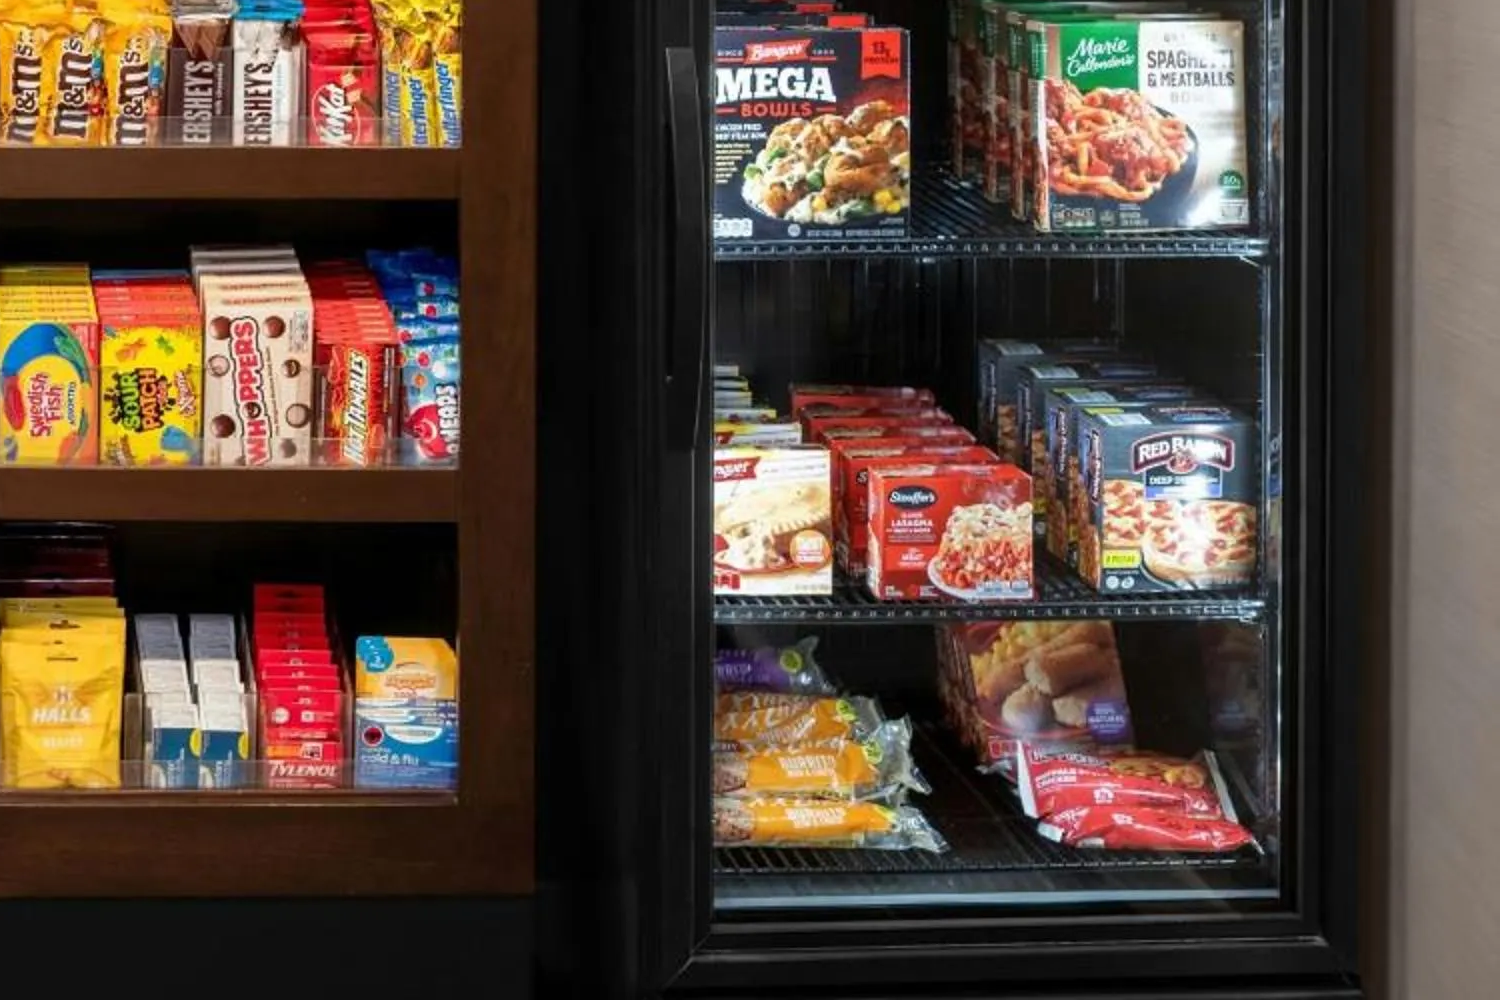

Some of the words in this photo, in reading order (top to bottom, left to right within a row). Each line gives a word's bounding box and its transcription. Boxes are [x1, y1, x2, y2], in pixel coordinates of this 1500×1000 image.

[1069, 37, 1130, 59] Marie
[716, 67, 837, 104] MEGA
[1160, 71, 1235, 87] MEATBALLS
[183, 60, 213, 144] ERSHEY'S
[244, 62, 273, 145] ERSHEY'S
[741, 102, 813, 118] BOWLS
[28, 372, 51, 438] Swedish
[120, 374, 141, 429] SOUR
[139, 368, 161, 430] PATCH
[1138, 441, 1170, 463] RED
[269, 760, 338, 777] TYLENOL
